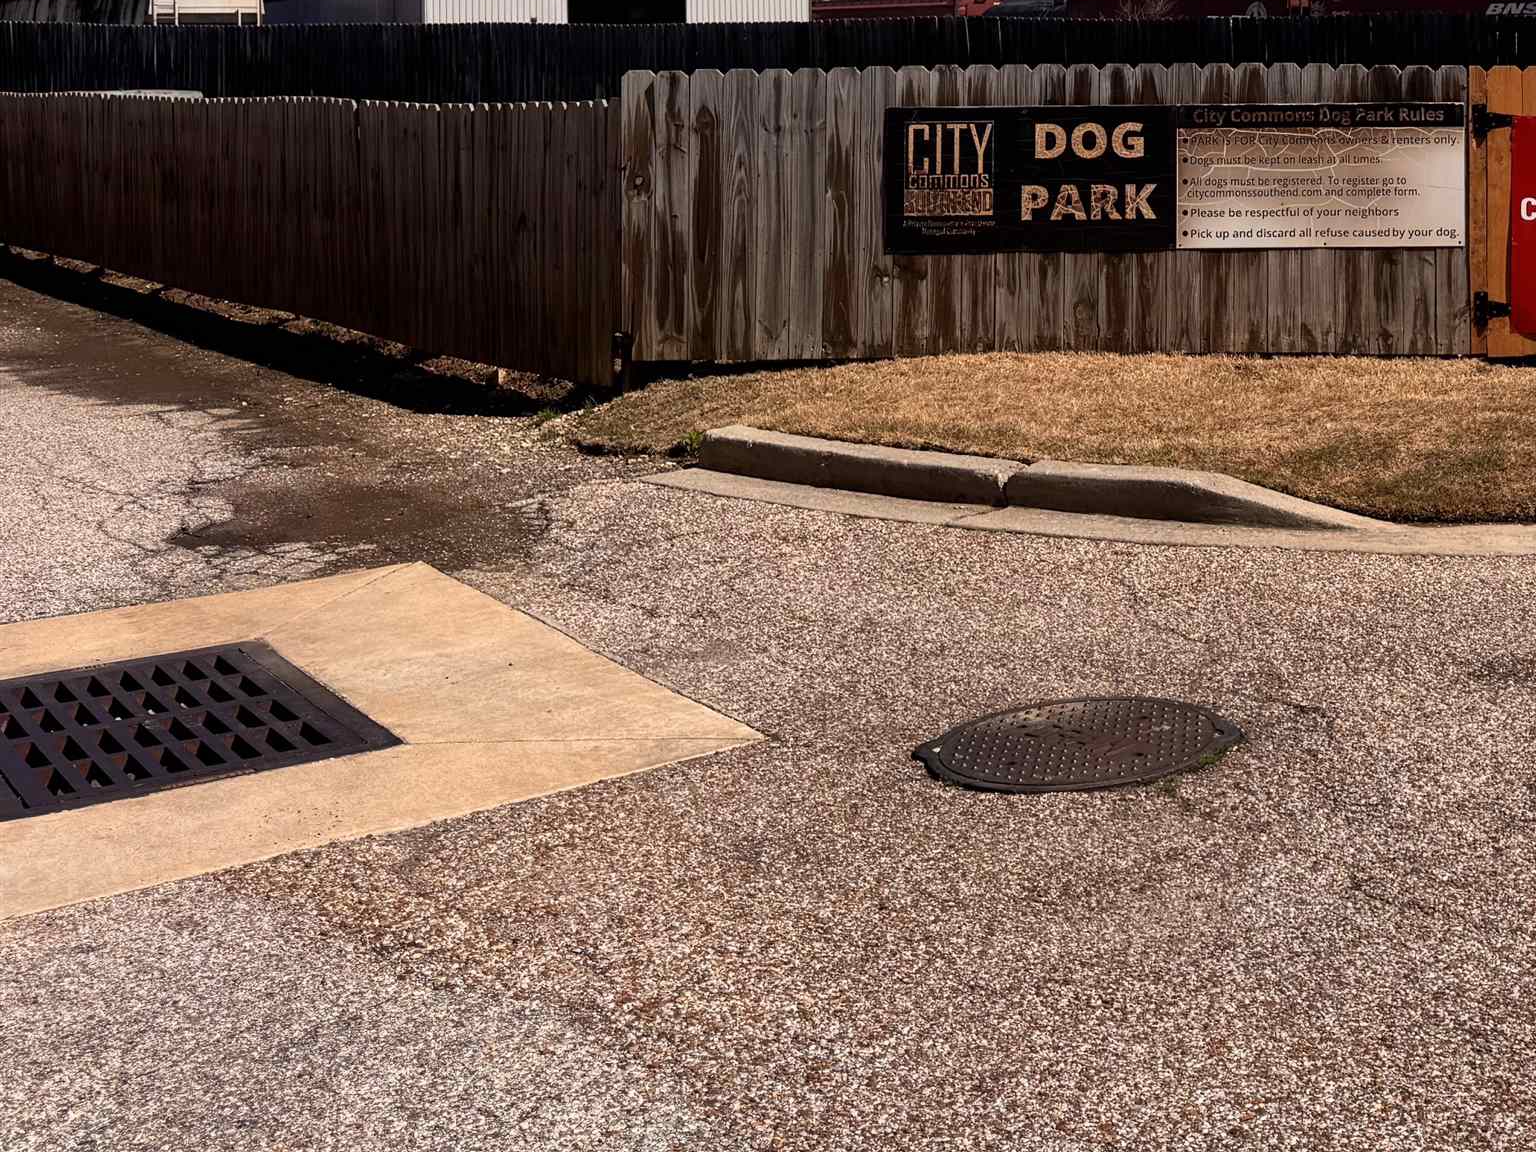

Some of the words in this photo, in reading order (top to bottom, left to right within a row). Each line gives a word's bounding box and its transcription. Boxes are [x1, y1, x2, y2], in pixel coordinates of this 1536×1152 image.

[1192, 108, 1225, 127] City
[1231, 109, 1315, 123] Commons
[1320, 107, 1351, 126] Dog
[1400, 107, 1445, 122] Rules
[1035, 122, 1145, 159] DOG
[1191, 136, 1221, 146] PARK
[1234, 136, 1257, 146] FOR
[1259, 135, 1280, 148] City
[1282, 136, 1336, 146] Commons
[1339, 135, 1378, 145] owners
[1381, 135, 1390, 145] &
[1392, 134, 1431, 145] renters
[1433, 134, 1460, 147] only.
[908, 123, 993, 175] CITY
[1190, 155, 1213, 167] Dogs
[1216, 155, 1241, 165] must
[1244, 155, 1257, 165] be
[1260, 154, 1281, 167] kept
[1283, 156, 1297, 165] on
[1299, 154, 1325, 165] leash
[1327, 155, 1336, 165] at
[1340, 154, 1351, 164] all
[1189, 176, 1202, 187] All
[1204, 176, 1228, 189] dogs
[1230, 177, 1255, 187] must
[1258, 176, 1270, 186] be
[1328, 176, 1339, 186] To
[1342, 175, 1380, 189] register
[1382, 177, 1394, 189] go
[1396, 175, 1407, 186] to
[1324, 187, 1344, 197] and
[1345, 187, 1392, 199] complete
[1394, 187, 1421, 197] form.
[1021, 184, 1157, 221] PARK
[1190, 208, 1225, 218] Please
[1228, 208, 1242, 218] be
[1245, 207, 1300, 220] respectful
[1302, 207, 1313, 218] of
[1316, 209, 1341, 220] your
[1344, 208, 1400, 219] neighbors
[1190, 228, 1213, 239] Pick
[1215, 231, 1230, 241] up
[1232, 228, 1254, 239] and
[1256, 228, 1296, 239] discard
[1299, 228, 1312, 238] all
[1315, 228, 1350, 238] refuse
[1352, 227, 1391, 238] caused
[1392, 227, 1405, 240] by
[1407, 229, 1433, 240] your
[1436, 227, 1460, 240] dog.
